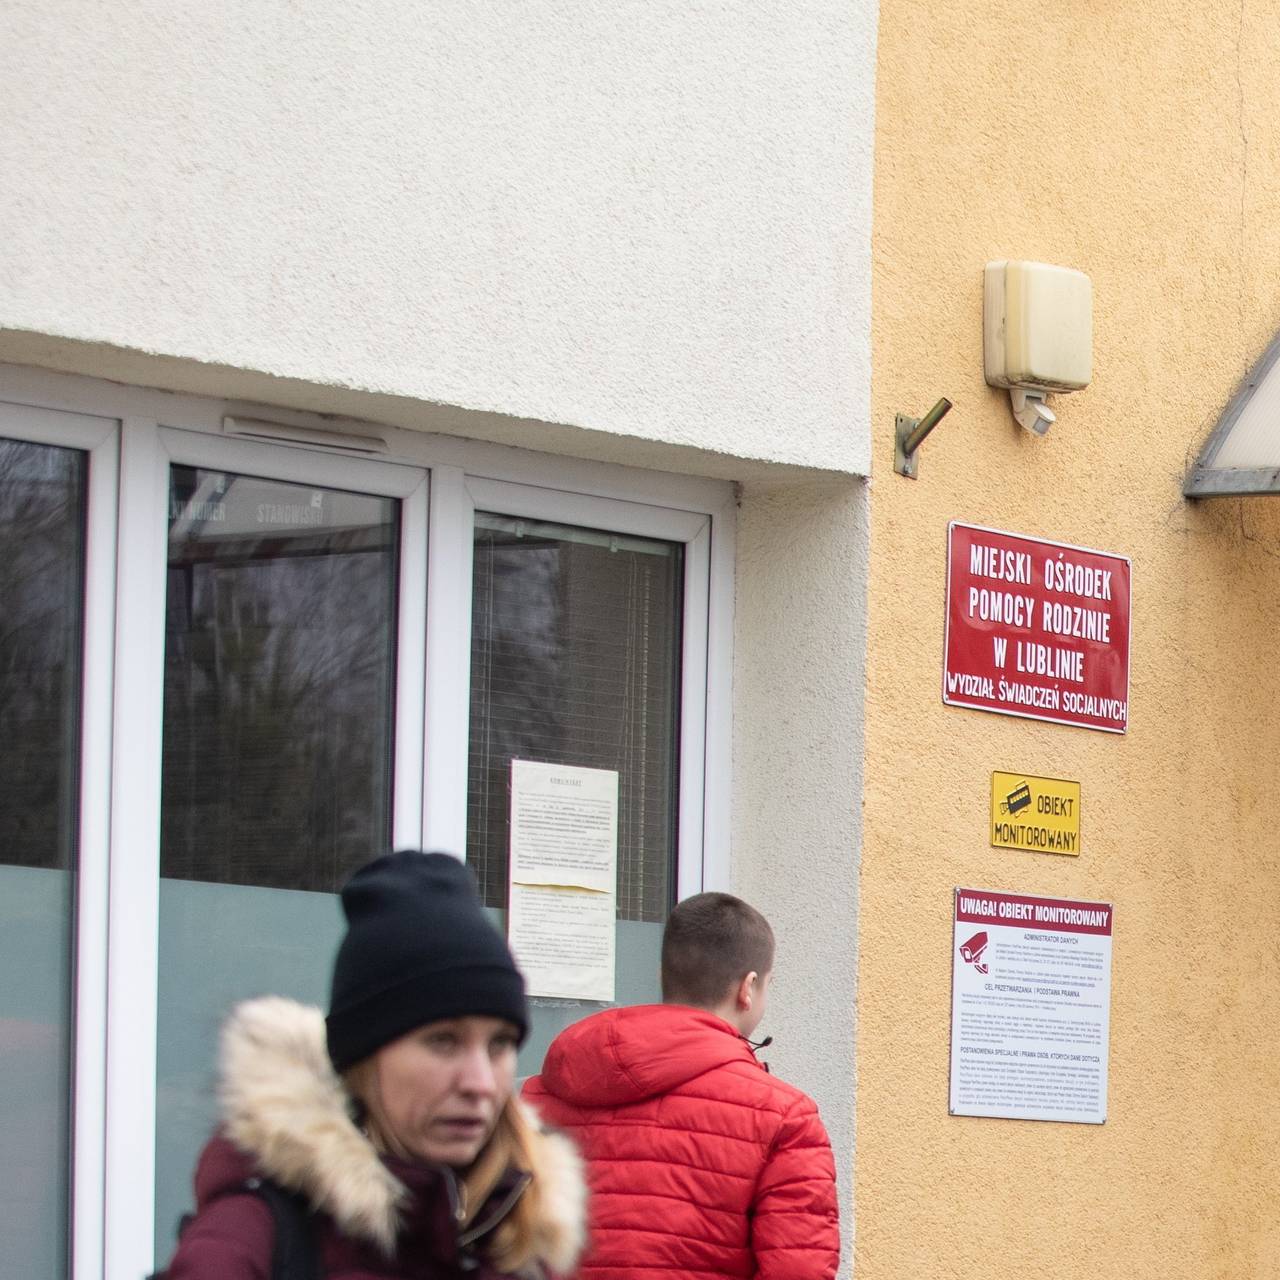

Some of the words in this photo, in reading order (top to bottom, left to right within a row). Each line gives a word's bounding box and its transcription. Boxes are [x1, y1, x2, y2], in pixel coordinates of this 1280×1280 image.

[970, 544, 1032, 585] MIEJSKI
[1044, 552, 1112, 601] OŚRODEK
[969, 586, 1035, 628] POMOCY
[1043, 600, 1111, 643] RODZINIE
[993, 637, 1008, 668] W
[1017, 640, 1084, 683] LUBLINIE
[947, 671, 996, 700] WYDZIAŁ
[998, 675, 1060, 710] ŚWIADCZEŃ
[1063, 690, 1127, 721] SOCJALNYCH
[1037, 794, 1074, 817] OBIEKT
[994, 823, 1077, 851] MONITOROWANY
[960, 896, 997, 916] UWAGA!
[999, 901, 1034, 921] OBIEKT
[1035, 906, 1109, 928] MONITOROWANY
